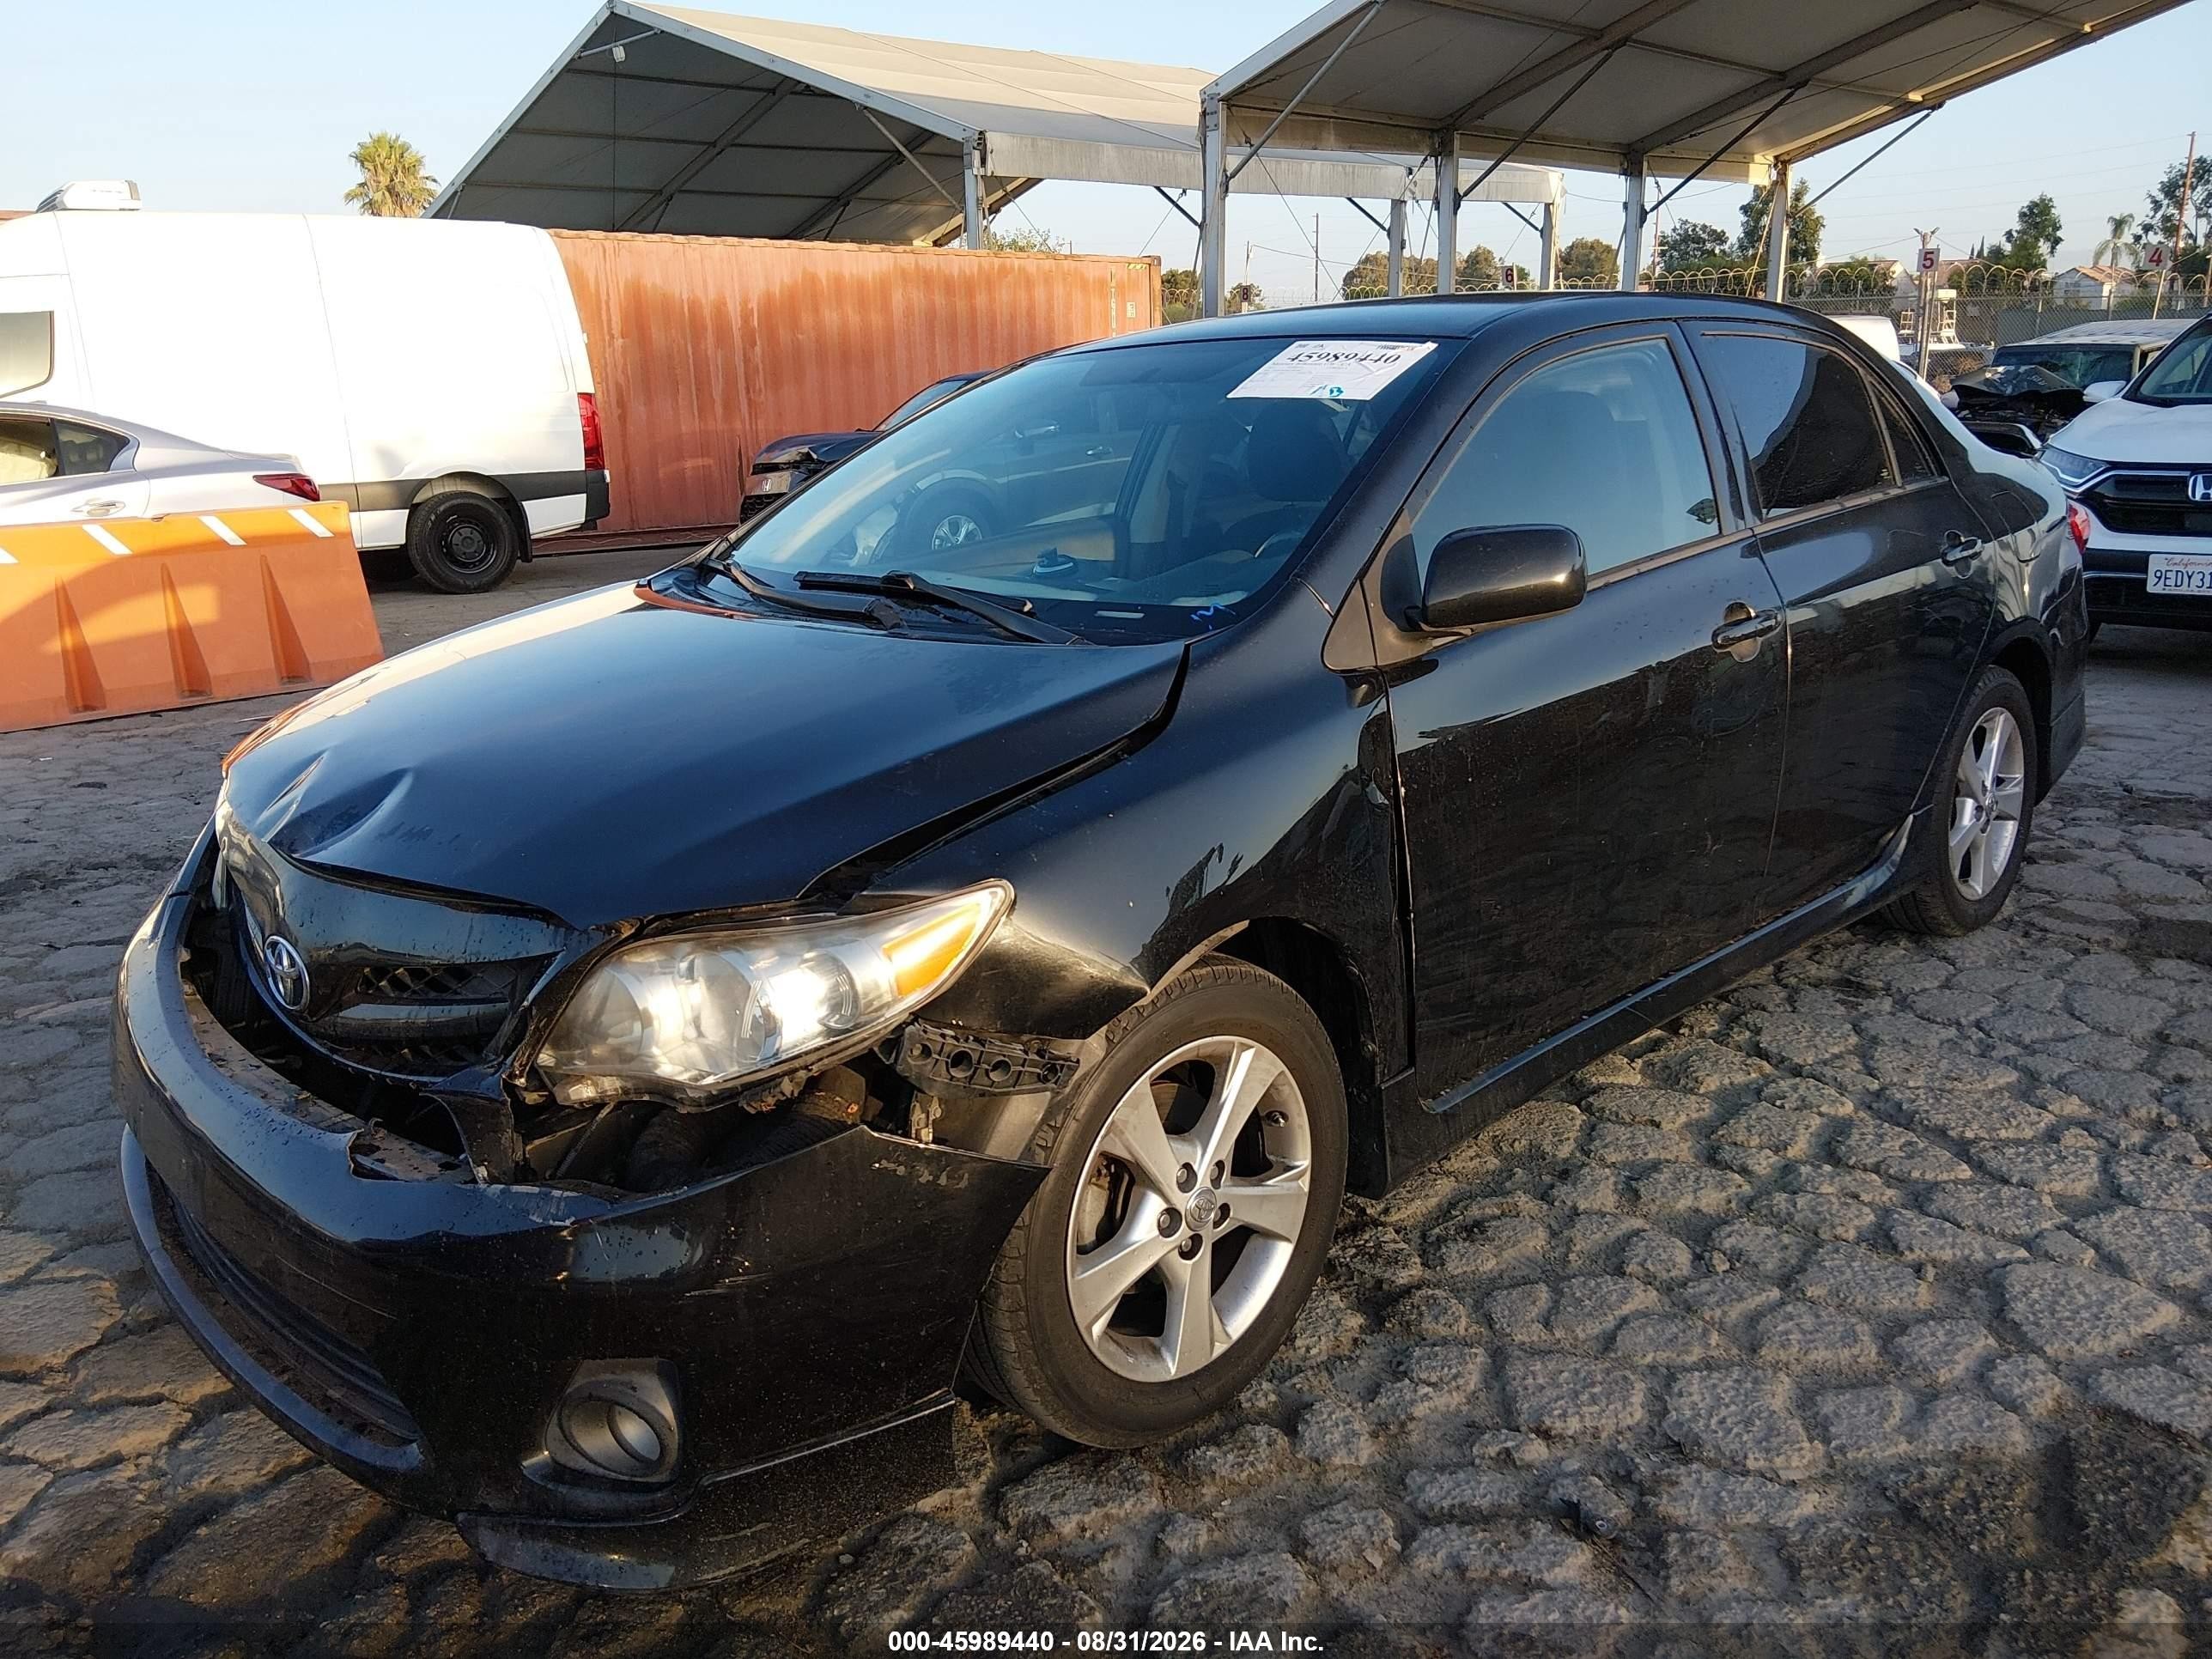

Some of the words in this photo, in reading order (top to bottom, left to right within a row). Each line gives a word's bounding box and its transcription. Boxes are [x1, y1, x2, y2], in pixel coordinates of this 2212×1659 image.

[1922, 251, 1935, 270] 5
[2148, 246, 2163, 267] 4
[1505, 267, 1514, 283] 6
[1242, 287, 1249, 301] 8
[1287, 351, 1401, 364] 45989440
